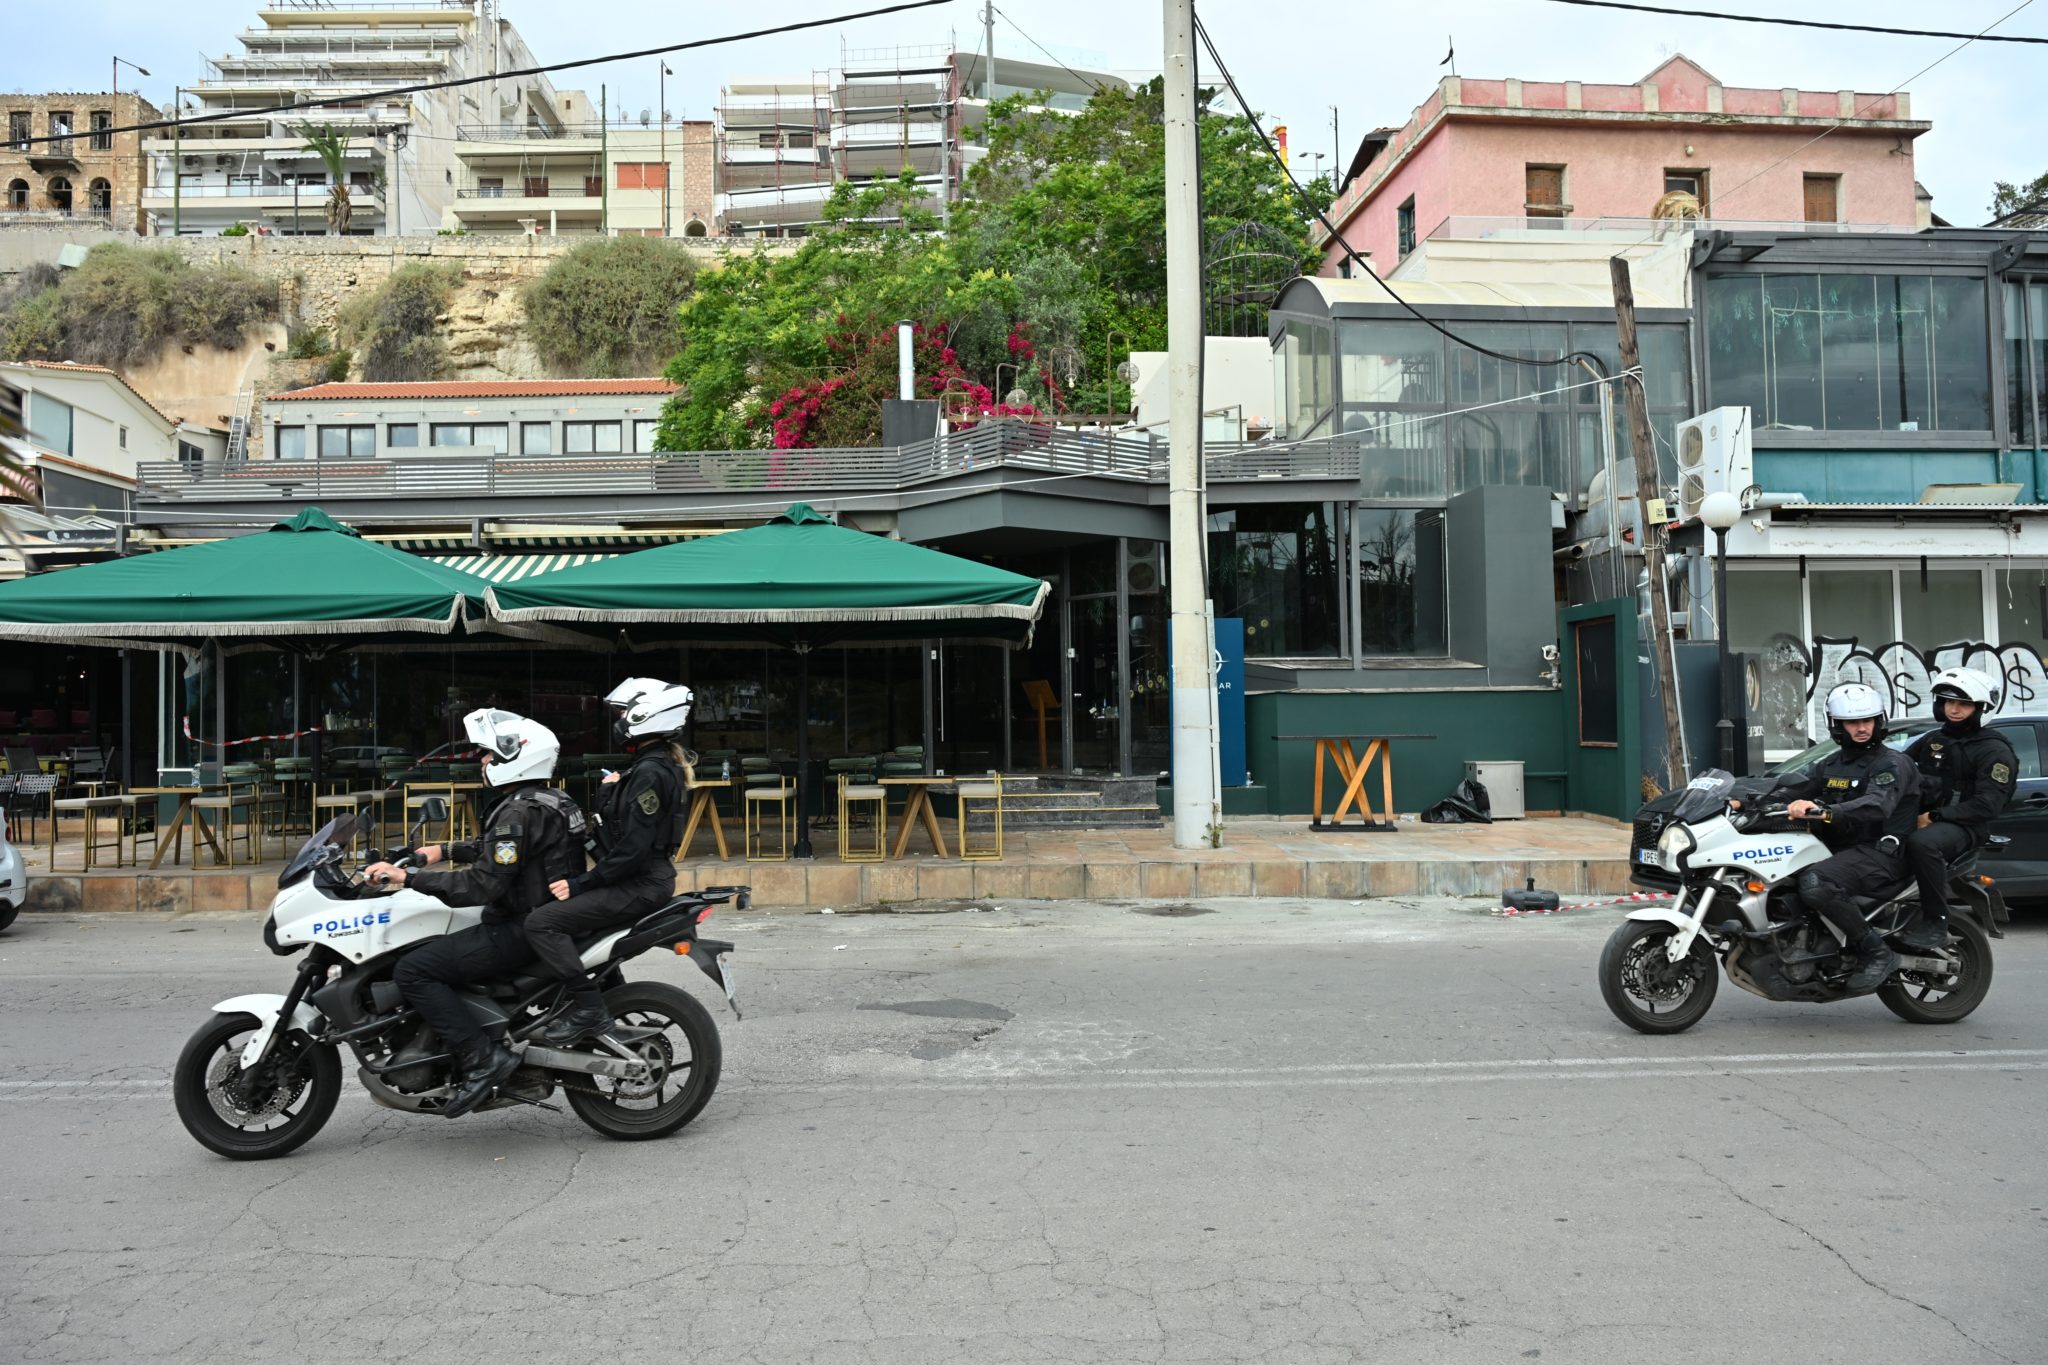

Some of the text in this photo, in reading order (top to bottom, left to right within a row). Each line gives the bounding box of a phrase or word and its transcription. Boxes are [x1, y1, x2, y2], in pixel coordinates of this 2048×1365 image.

[1732, 845, 1794, 860] POLICE
[313, 911, 390, 934] POLICE
[328, 928, 364, 939] Kawasaki
